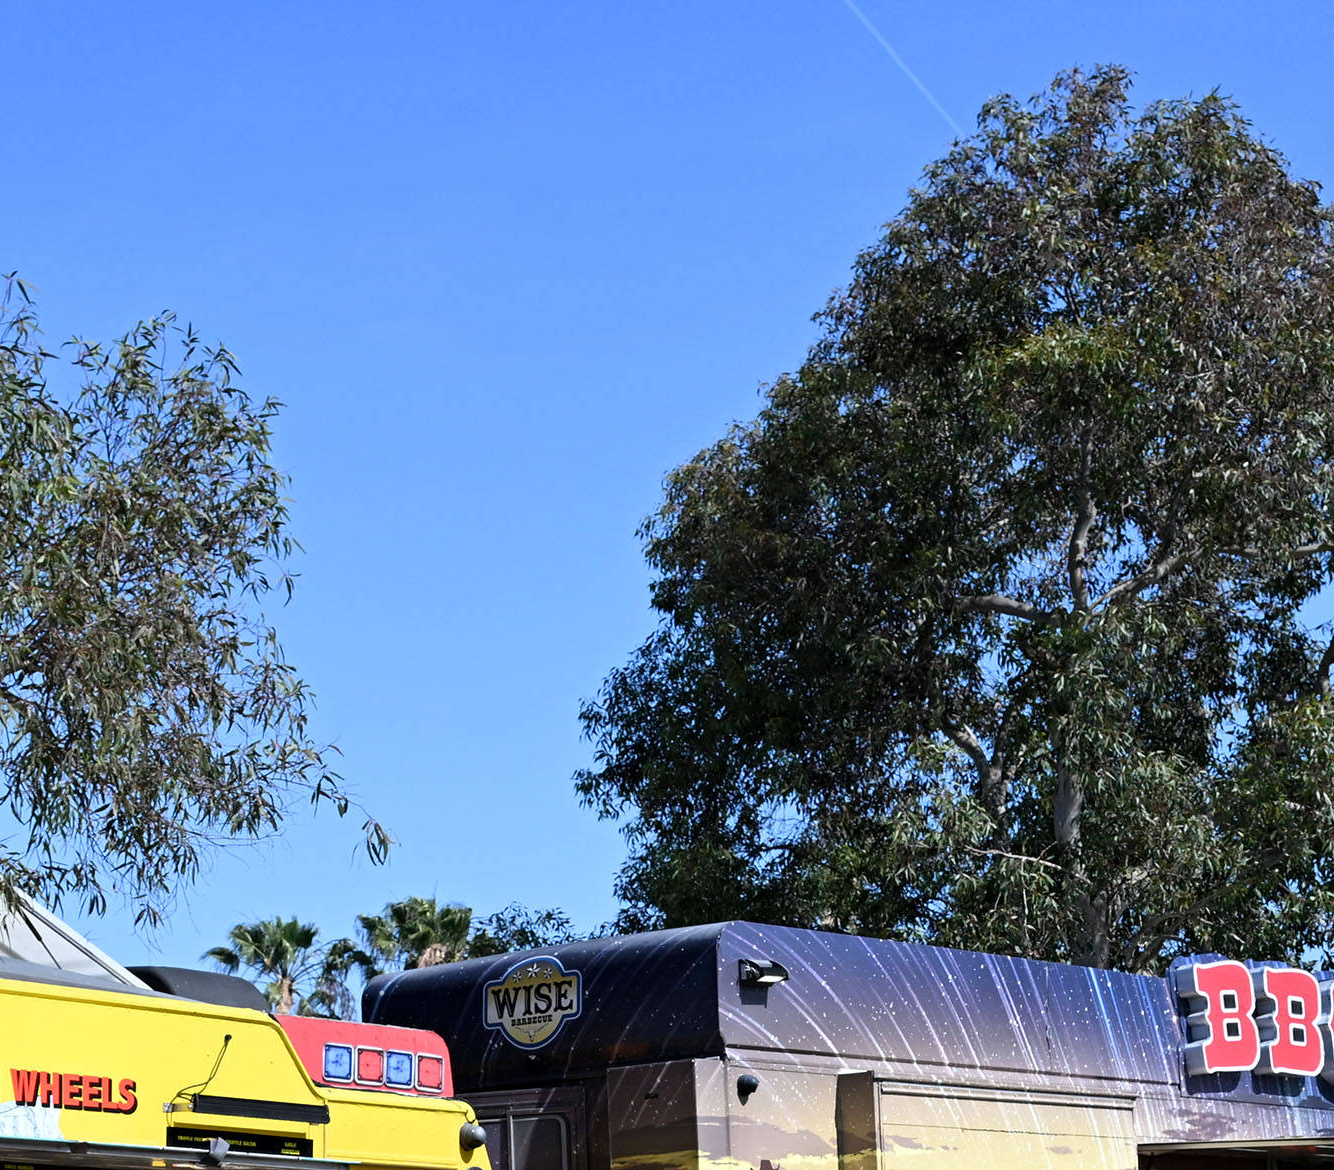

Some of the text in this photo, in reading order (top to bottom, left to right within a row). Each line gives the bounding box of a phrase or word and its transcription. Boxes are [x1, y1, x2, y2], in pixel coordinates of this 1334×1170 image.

[491, 980, 574, 1020] WISE
[511, 1014, 553, 1027] BARBECUE
[10, 1069, 138, 1115] WHEELS
